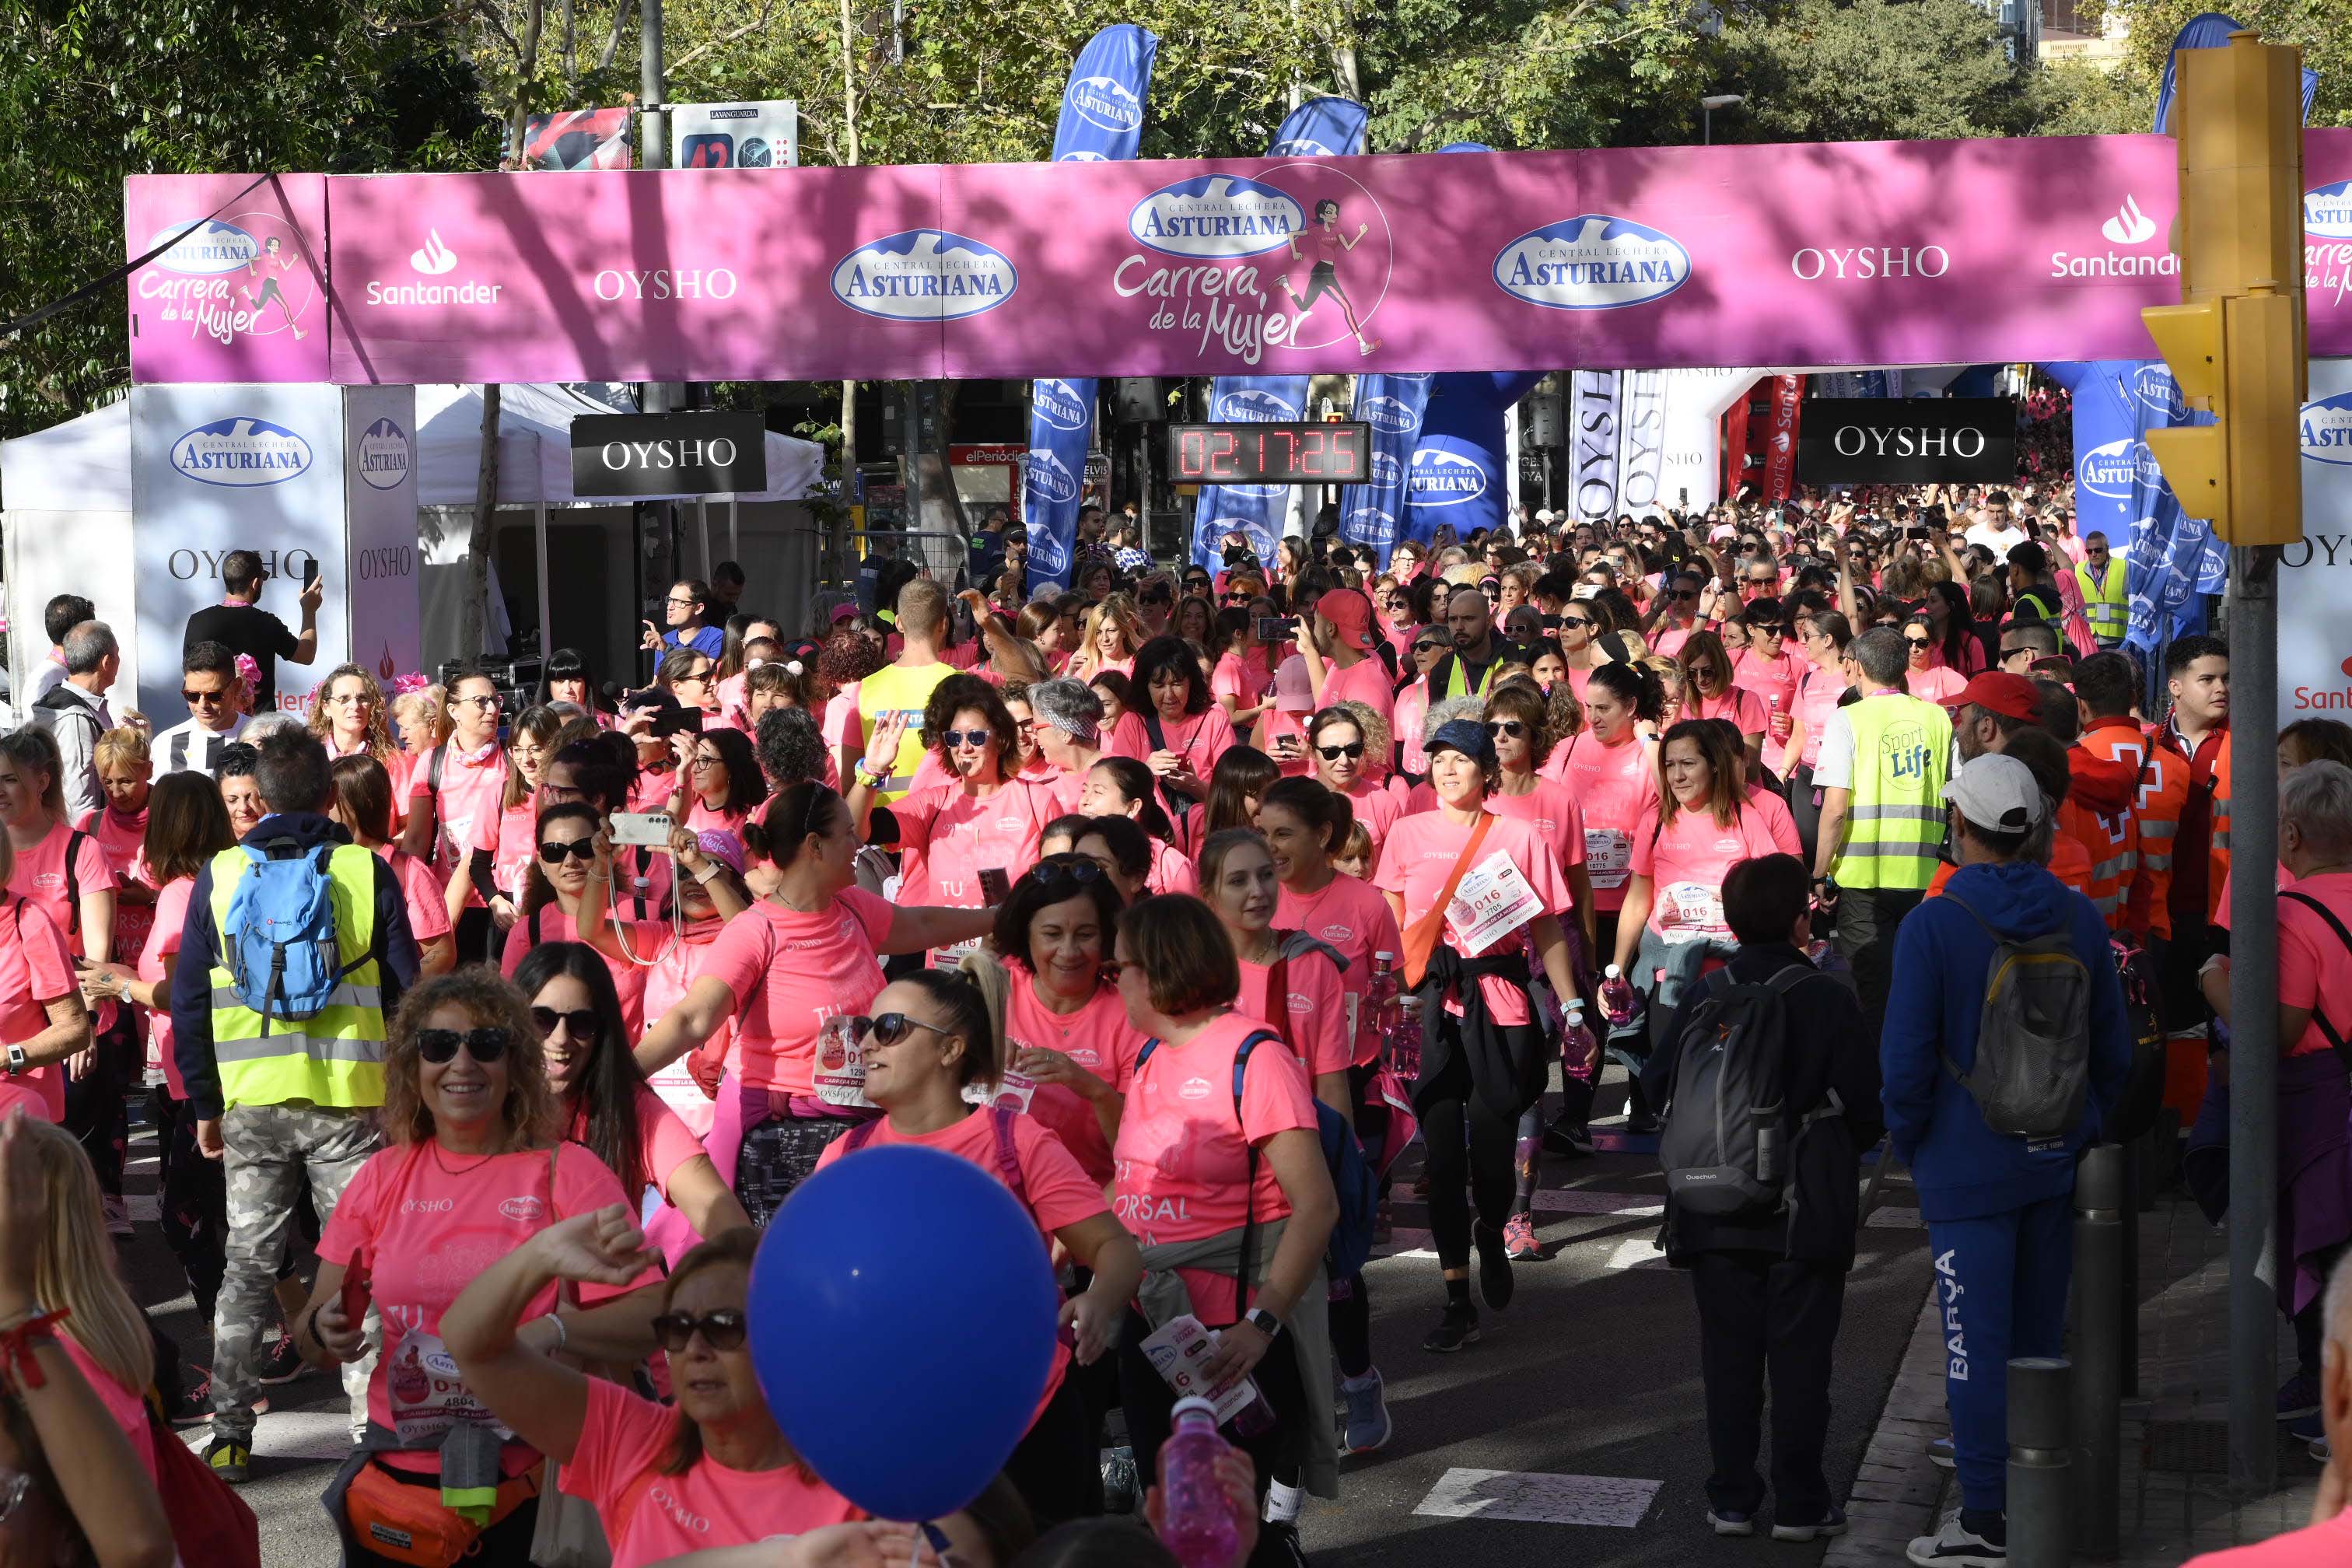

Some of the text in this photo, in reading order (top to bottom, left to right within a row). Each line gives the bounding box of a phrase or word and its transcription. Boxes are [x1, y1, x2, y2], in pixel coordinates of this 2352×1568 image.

[719, 109, 758, 118] VANGUARDIA
[1169, 201, 1286, 212] CENTRAL LECHERA
[1142, 207, 1292, 237] ASTURIANA
[1538, 247, 1668, 258] CENTRAL LECHERA
[1791, 245, 1950, 280] OYSHO
[2051, 251, 2181, 278] Santand
[873, 261, 996, 271] CENTRAL LECHERA
[1113, 254, 1259, 298] Carrera
[1508, 251, 1676, 286] ASTURIANA
[2323, 267, 2338, 289] la
[138, 270, 229, 299] Carrera
[366, 281, 502, 306] Santander
[593, 268, 737, 301] OYSHO
[845, 264, 1004, 297] ASTURIANA
[161, 296, 264, 345] de la Mujer
[1149, 292, 1313, 365] de la Mujer
[601, 437, 737, 471] OYSHO
[1181, 431, 1355, 475] 02:17:25
[1834, 425, 1986, 458] OYSHO
[181, 443, 303, 469] ASTURIANA
[362, 445, 406, 472] ASTURIANA
[1083, 465, 1108, 474] ELVIS
[168, 548, 316, 580] OYHO
[359, 544, 411, 580] OYSHO
[1881, 726, 1925, 754] Sport
[1573, 763, 1601, 772] OYSHO
[1891, 744, 1932, 779] Life
[1587, 852, 1608, 861] 016
[940, 881, 964, 897] TU
[1474, 889, 1501, 911] 016
[1485, 902, 1503, 916] 7705
[1682, 907, 1708, 919] 016
[786, 939, 822, 953] OYSHO
[1475, 929, 1498, 947] OYSHO
[848, 1051, 864, 1065] 01
[824, 1077, 850, 1086] CARRERA
[2028, 1143, 2048, 1152] SINCE
[401, 1198, 453, 1214] OYSHO
[1934, 1249, 1969, 1381] BARÇA
